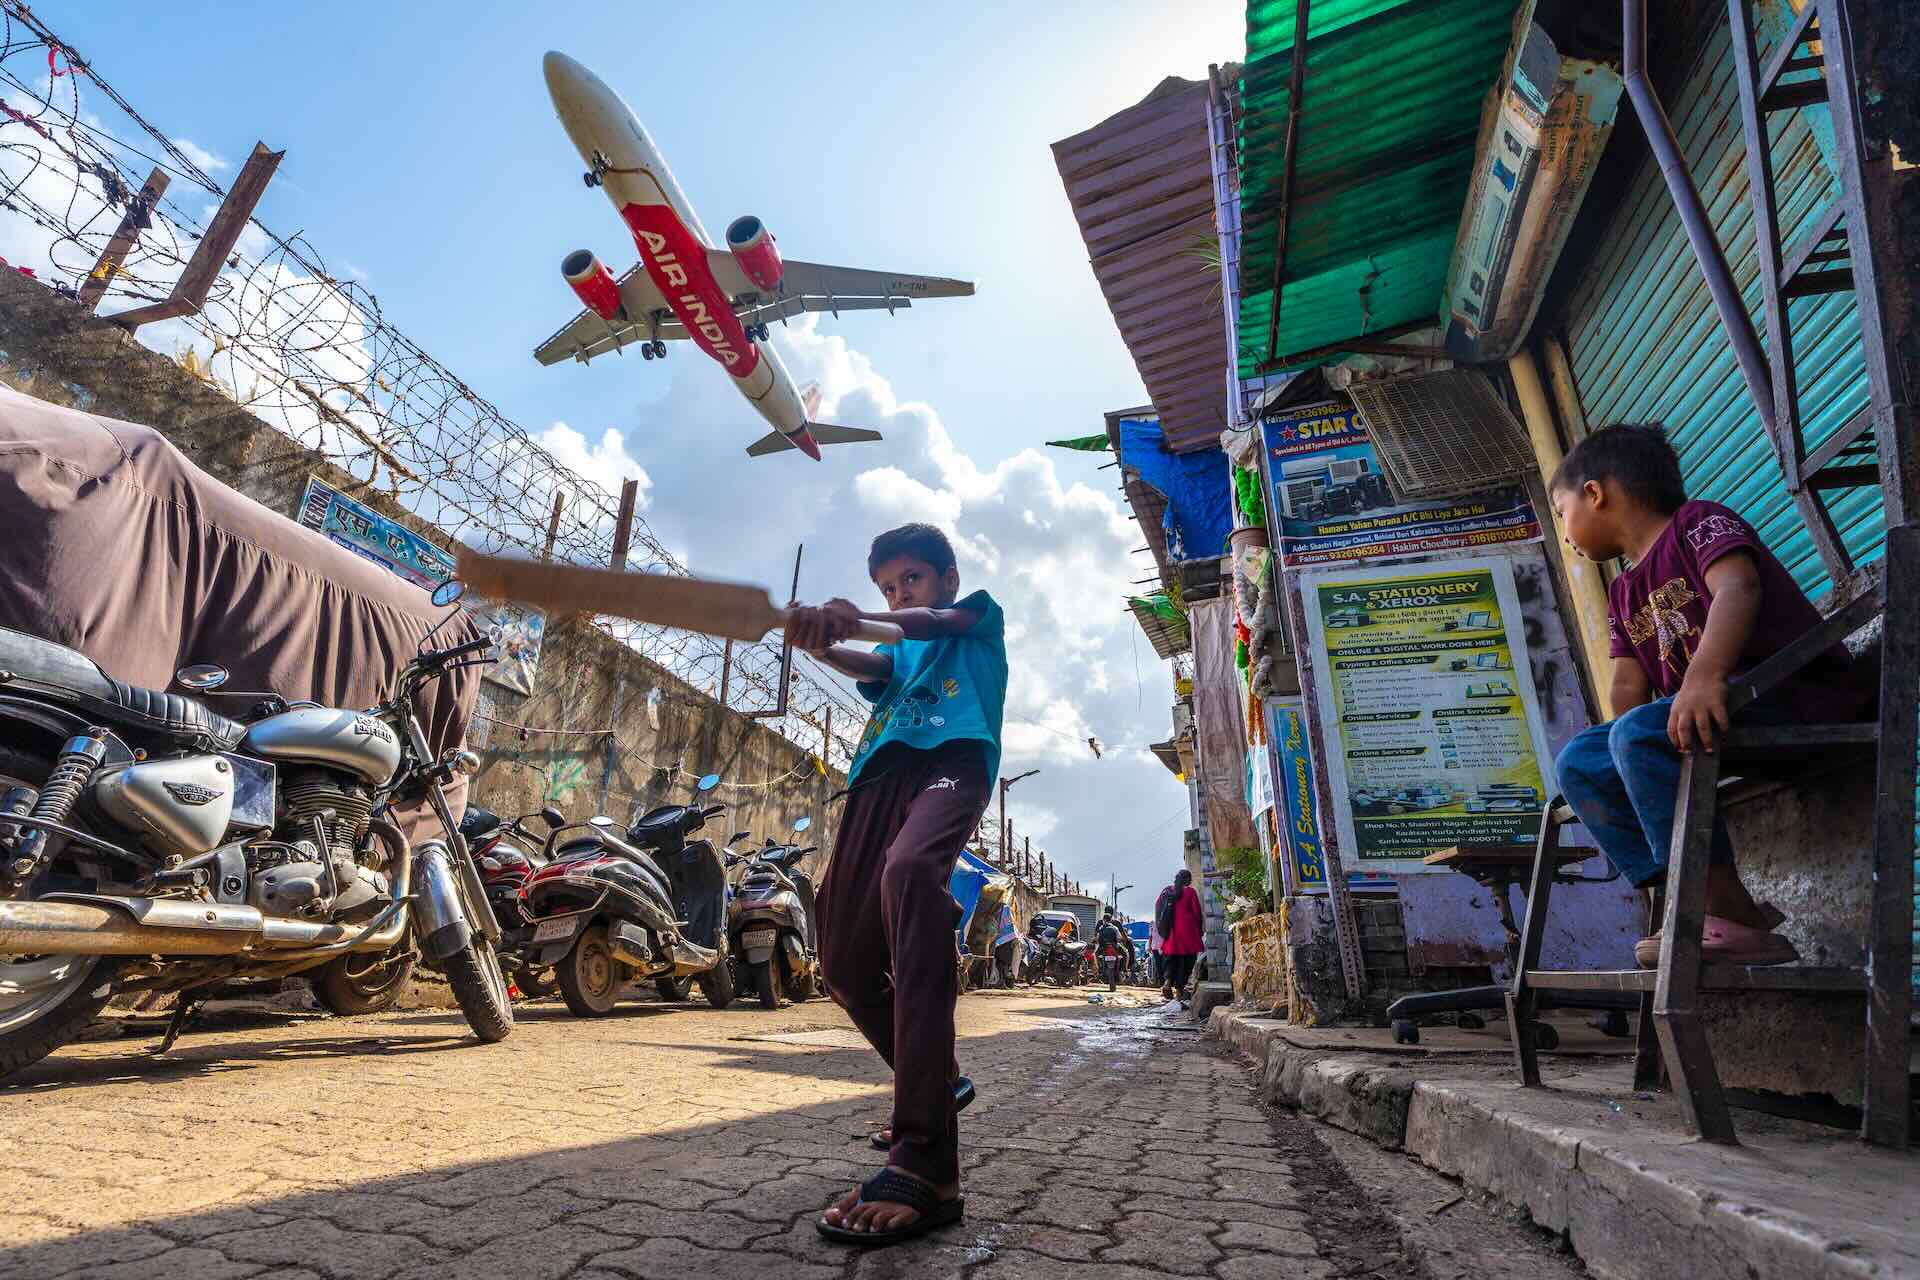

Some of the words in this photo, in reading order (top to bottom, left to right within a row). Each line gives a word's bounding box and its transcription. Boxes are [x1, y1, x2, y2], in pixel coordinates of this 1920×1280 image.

[638, 230, 688, 287] AIR
[680, 294, 740, 366] INDIA
[1297, 416, 1349, 439] STAR
[1349, 520, 1373, 531] Yahan
[1373, 516, 1402, 527] Purana
[1402, 511, 1419, 523] A/C
[1420, 510, 1433, 520] Bhi
[1392, 541, 1419, 553] Hakim
[1333, 592, 1366, 603] S.A.
[1368, 582, 1479, 600] STATIONERY
[1366, 601, 1377, 609] &
[1380, 595, 1440, 608] XEROX
[1338, 647, 1373, 656] ONLINE
[1383, 645, 1421, 653] DIGITAL
[1422, 641, 1448, 649] WORK
[1449, 640, 1473, 648] DONE
[1406, 656, 1426, 664] Work
[1437, 709, 1465, 717] Online
[1352, 750, 1380, 758] Online
[1296, 757, 1315, 836] Stationery
[1427, 836, 1460, 844] Mumbai
[1388, 849, 1422, 857] Service
